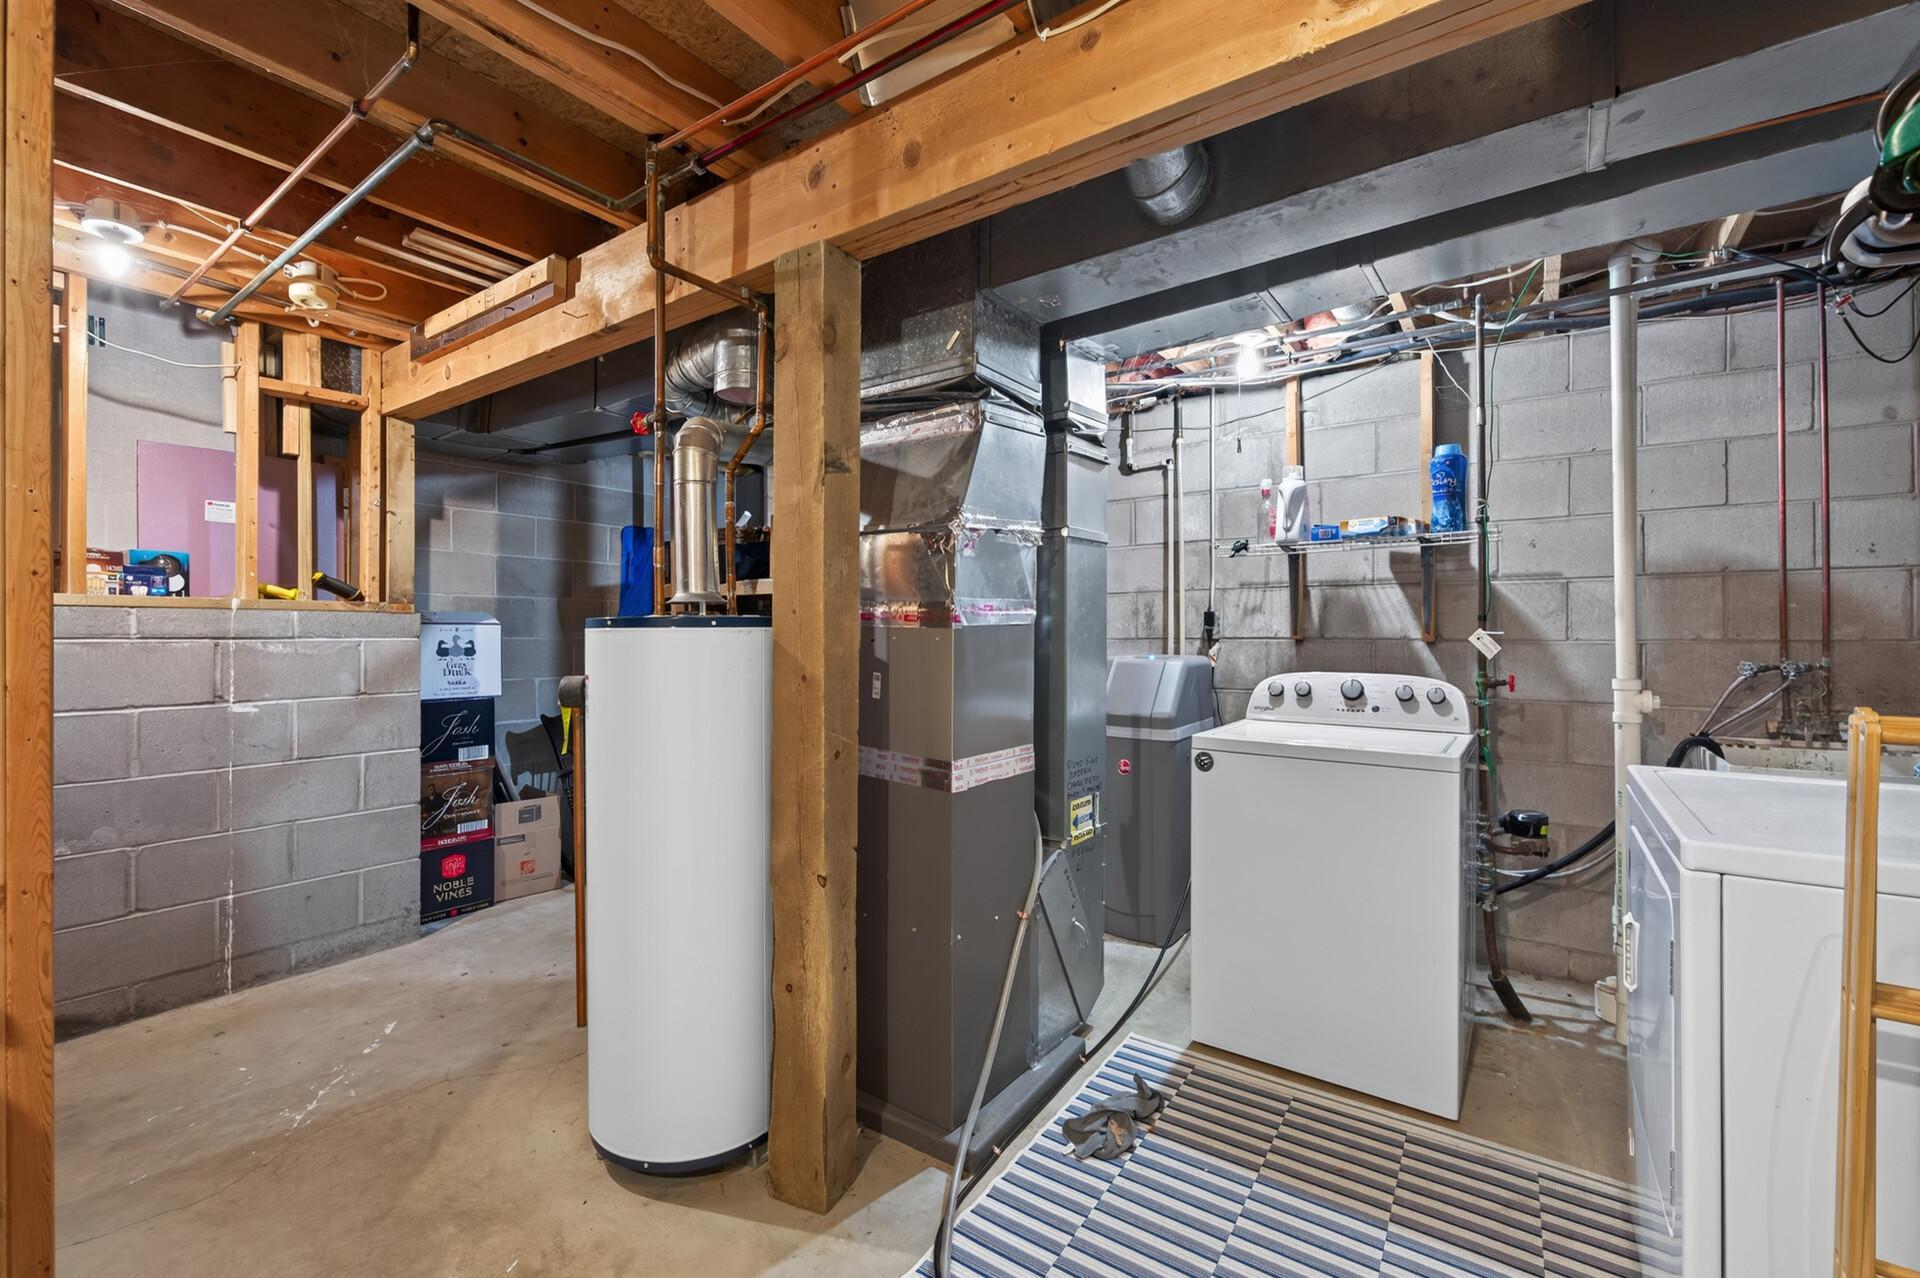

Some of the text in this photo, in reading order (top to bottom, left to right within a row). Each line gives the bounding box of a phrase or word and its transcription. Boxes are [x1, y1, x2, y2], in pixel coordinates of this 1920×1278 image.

[420, 710, 481, 758] Josh
[422, 782, 480, 831] Josh
[433, 876, 475, 894] NOBLE
[436, 887, 473, 903] VINES
